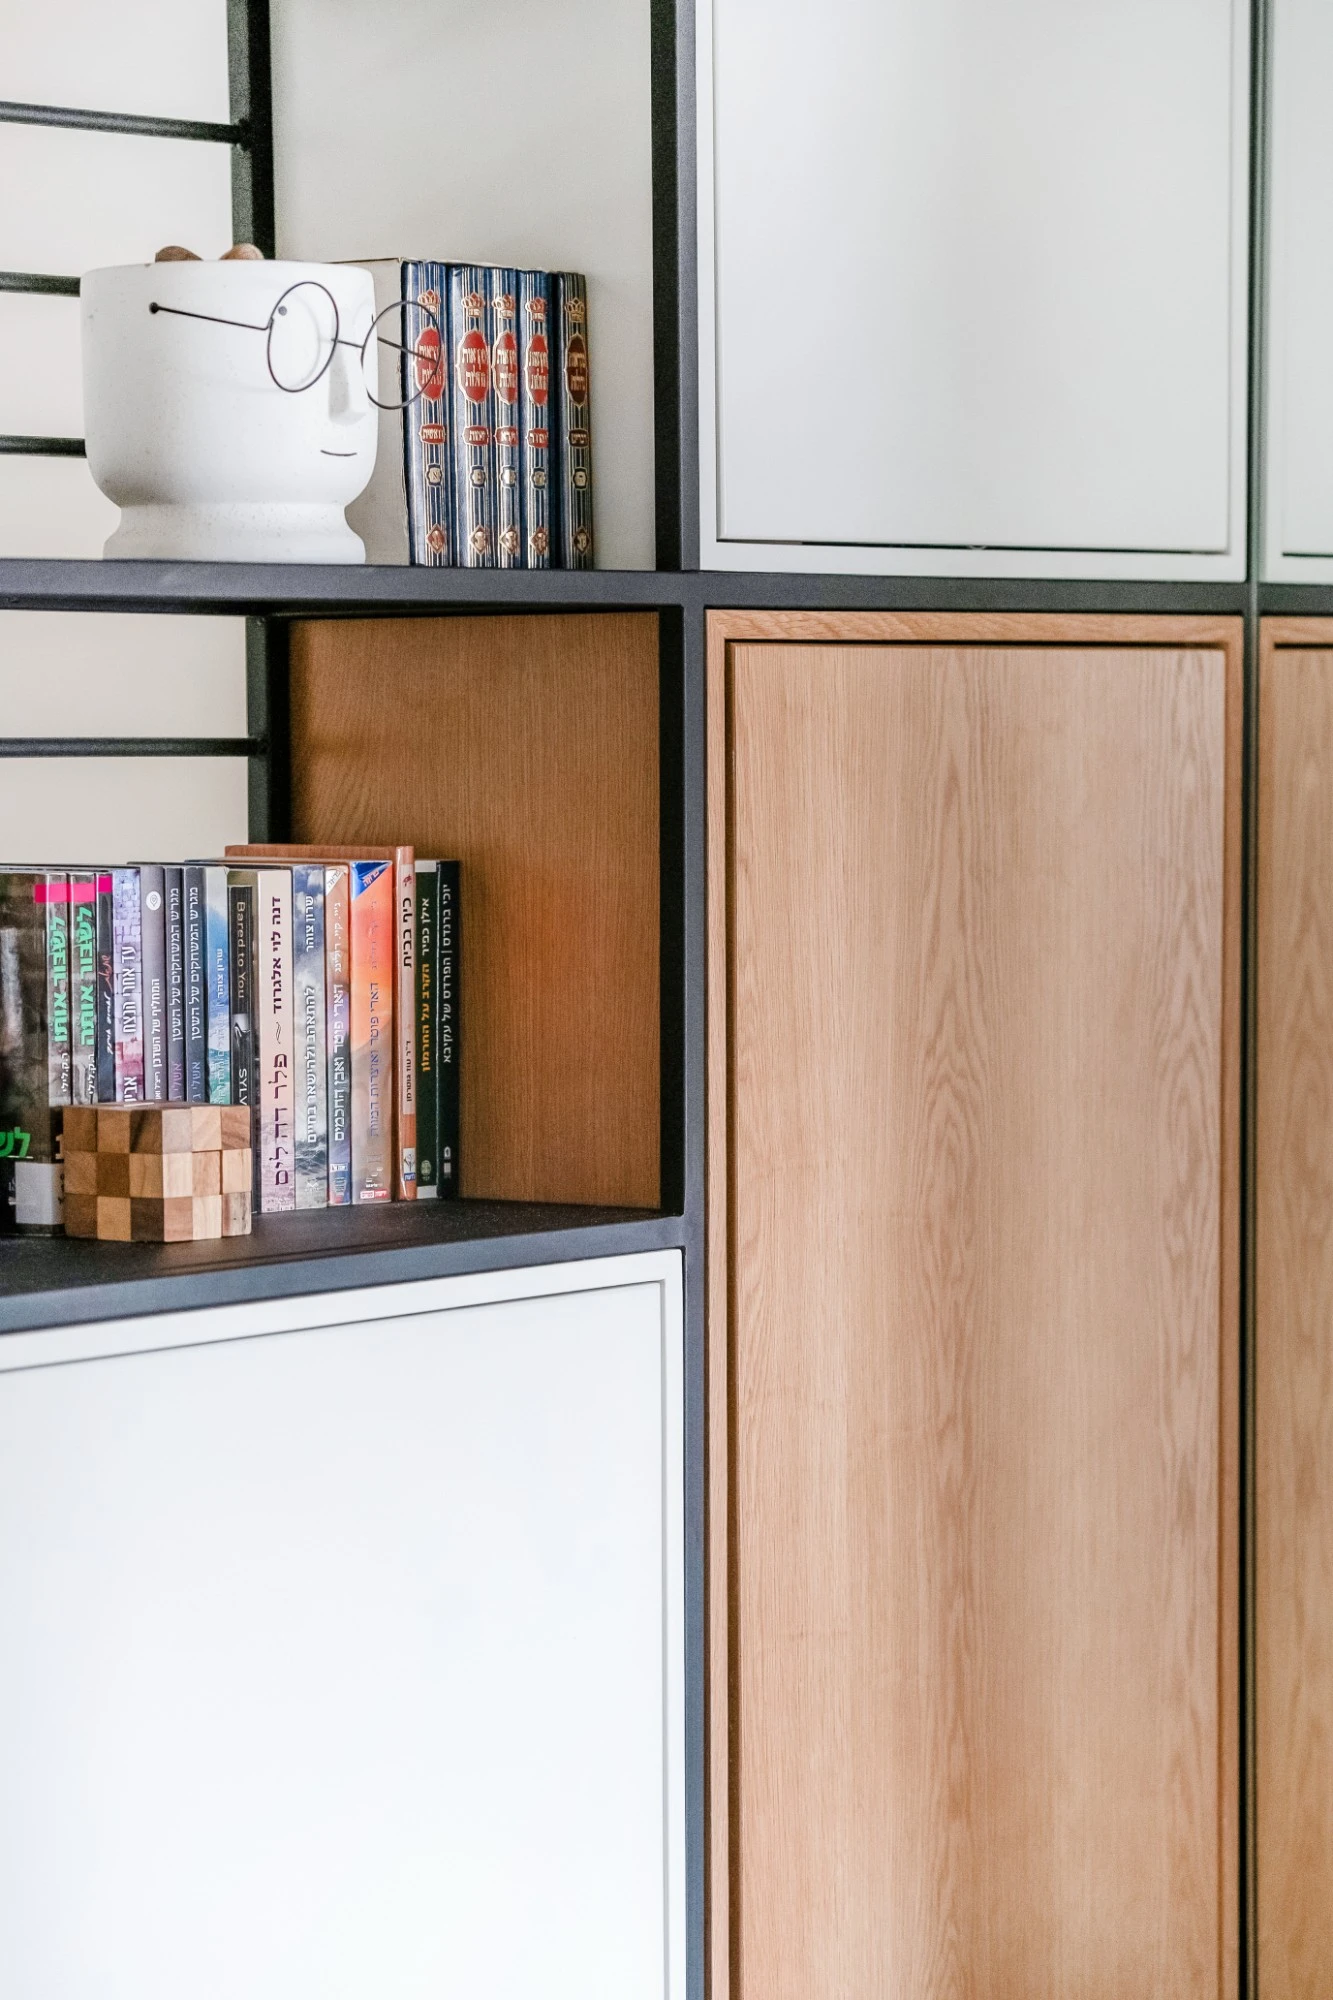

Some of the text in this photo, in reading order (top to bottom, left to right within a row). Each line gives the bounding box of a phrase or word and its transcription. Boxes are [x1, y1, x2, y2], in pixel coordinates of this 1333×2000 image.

[169, 888, 184, 1041] מגרש המשחקים של השטן
[188, 886, 202, 1041] מגרש המשחקים של השטן
[216, 948, 225, 971] שרון
[236, 901, 247, 998] Bared to You
[270, 896, 282, 1014] דנה לוי אלגרוד
[305, 895, 316, 953] שרון צוהר
[402, 897, 413, 968] כיף בבית
[420, 898, 431, 956] אילן כפיר
[442, 884, 452, 947] יוכי ברנדס
[50, 916, 68, 1042] לשבור אותו
[76, 906, 95, 1046] לשבור אותה
[121, 946, 137, 1033] עד אחרי הנצח
[150, 978, 162, 1068] המחליף של השדכן
[420, 963, 431, 1072] הקרב על החרמון
[441, 957, 453, 1063] הפרדס של עקיבא
[171, 1061, 183, 1091] אשלי
[191, 1061, 201, 1089] אשלי
[239, 1068, 248, 1105] SYLV
[303, 987, 317, 1143] להתאהב ולהישאר בחיים
[333, 984, 346, 1141] הארי פוטר ואבן החכמים
[370, 982, 380, 1137] הארי פוטר ואוצרות המוות
[268, 1053, 289, 1186] פלר דה לים
